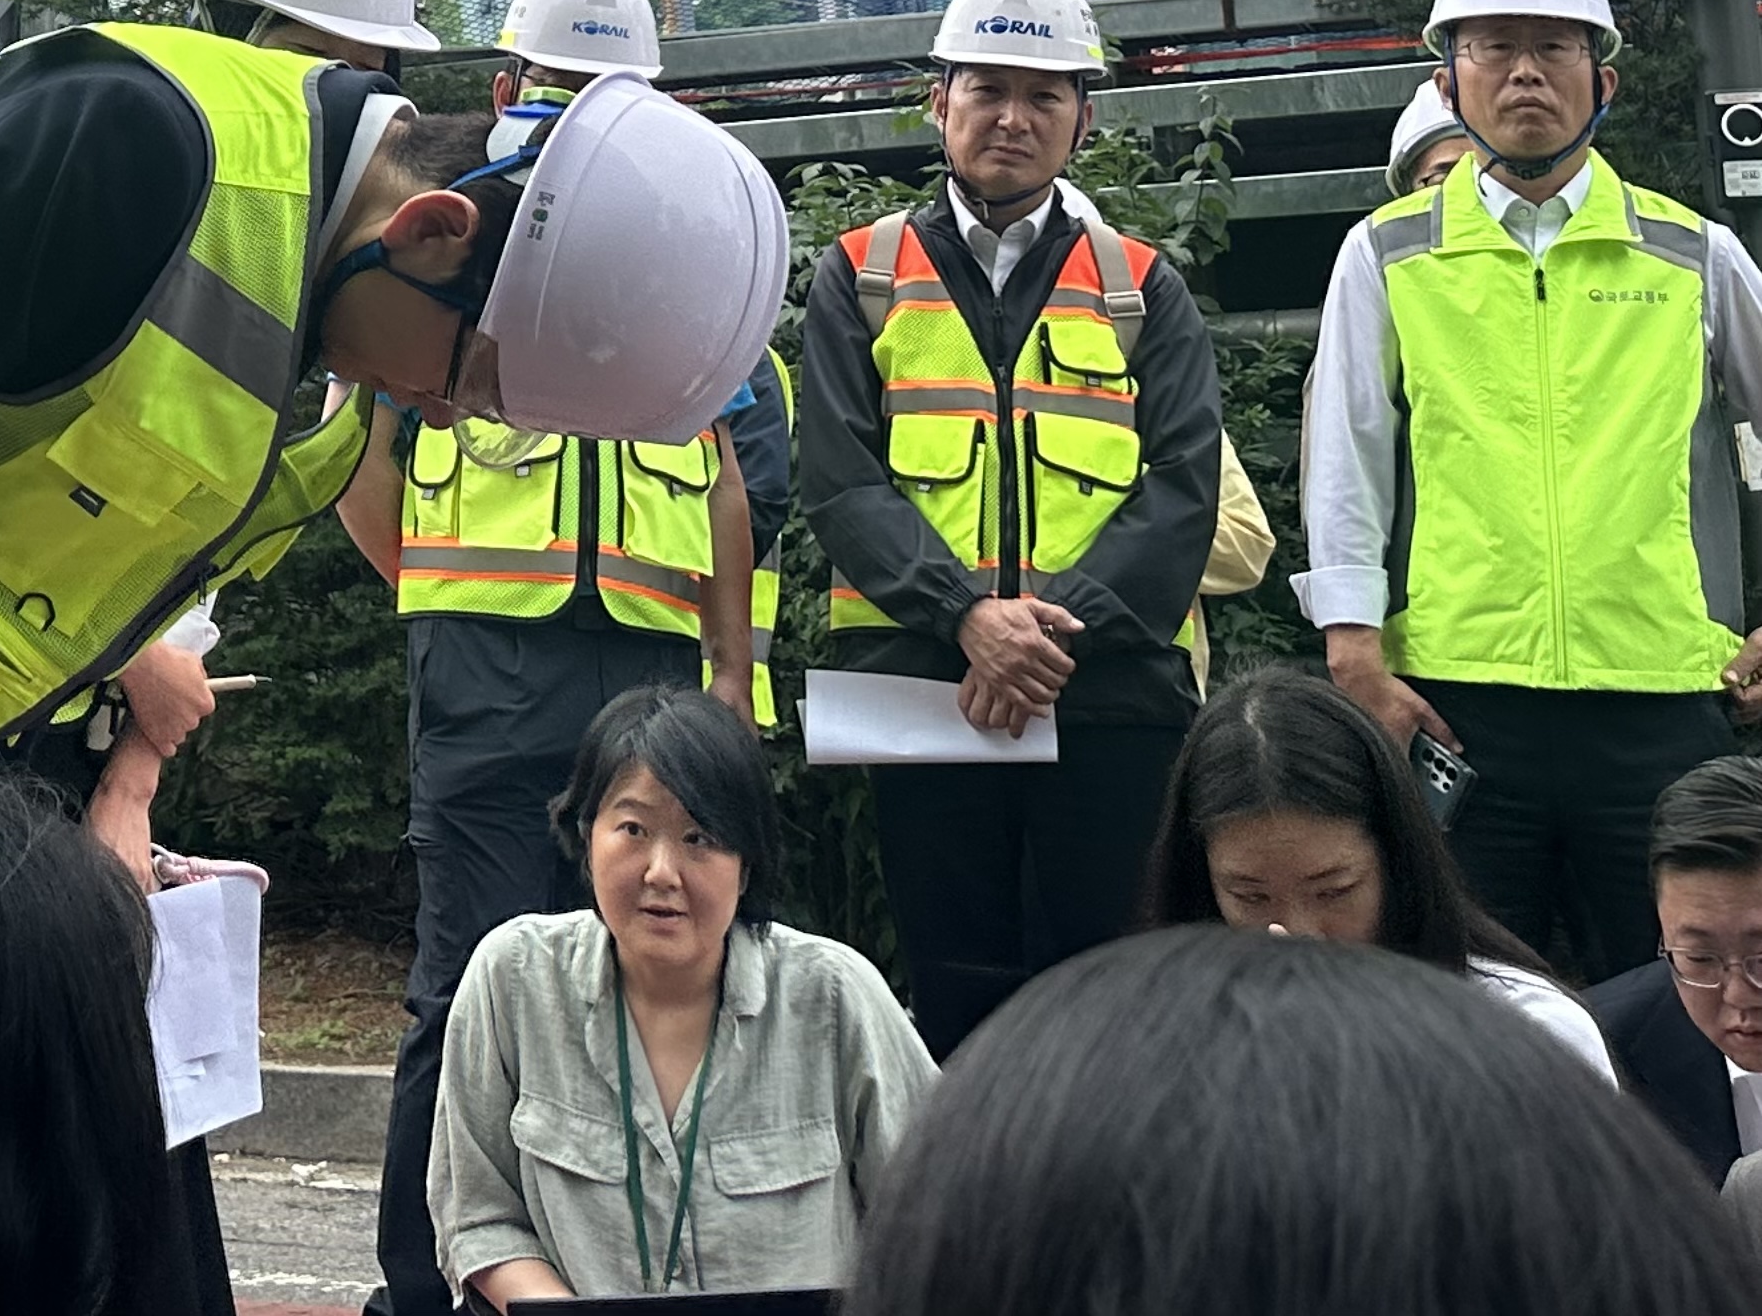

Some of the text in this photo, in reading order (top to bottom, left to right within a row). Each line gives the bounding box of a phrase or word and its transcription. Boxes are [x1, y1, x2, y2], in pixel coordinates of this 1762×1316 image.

[571, 20, 631, 39] KORAIL
[975, 15, 1054, 39] KORAIL
[1605, 290, 1670, 304] 국토교통부
